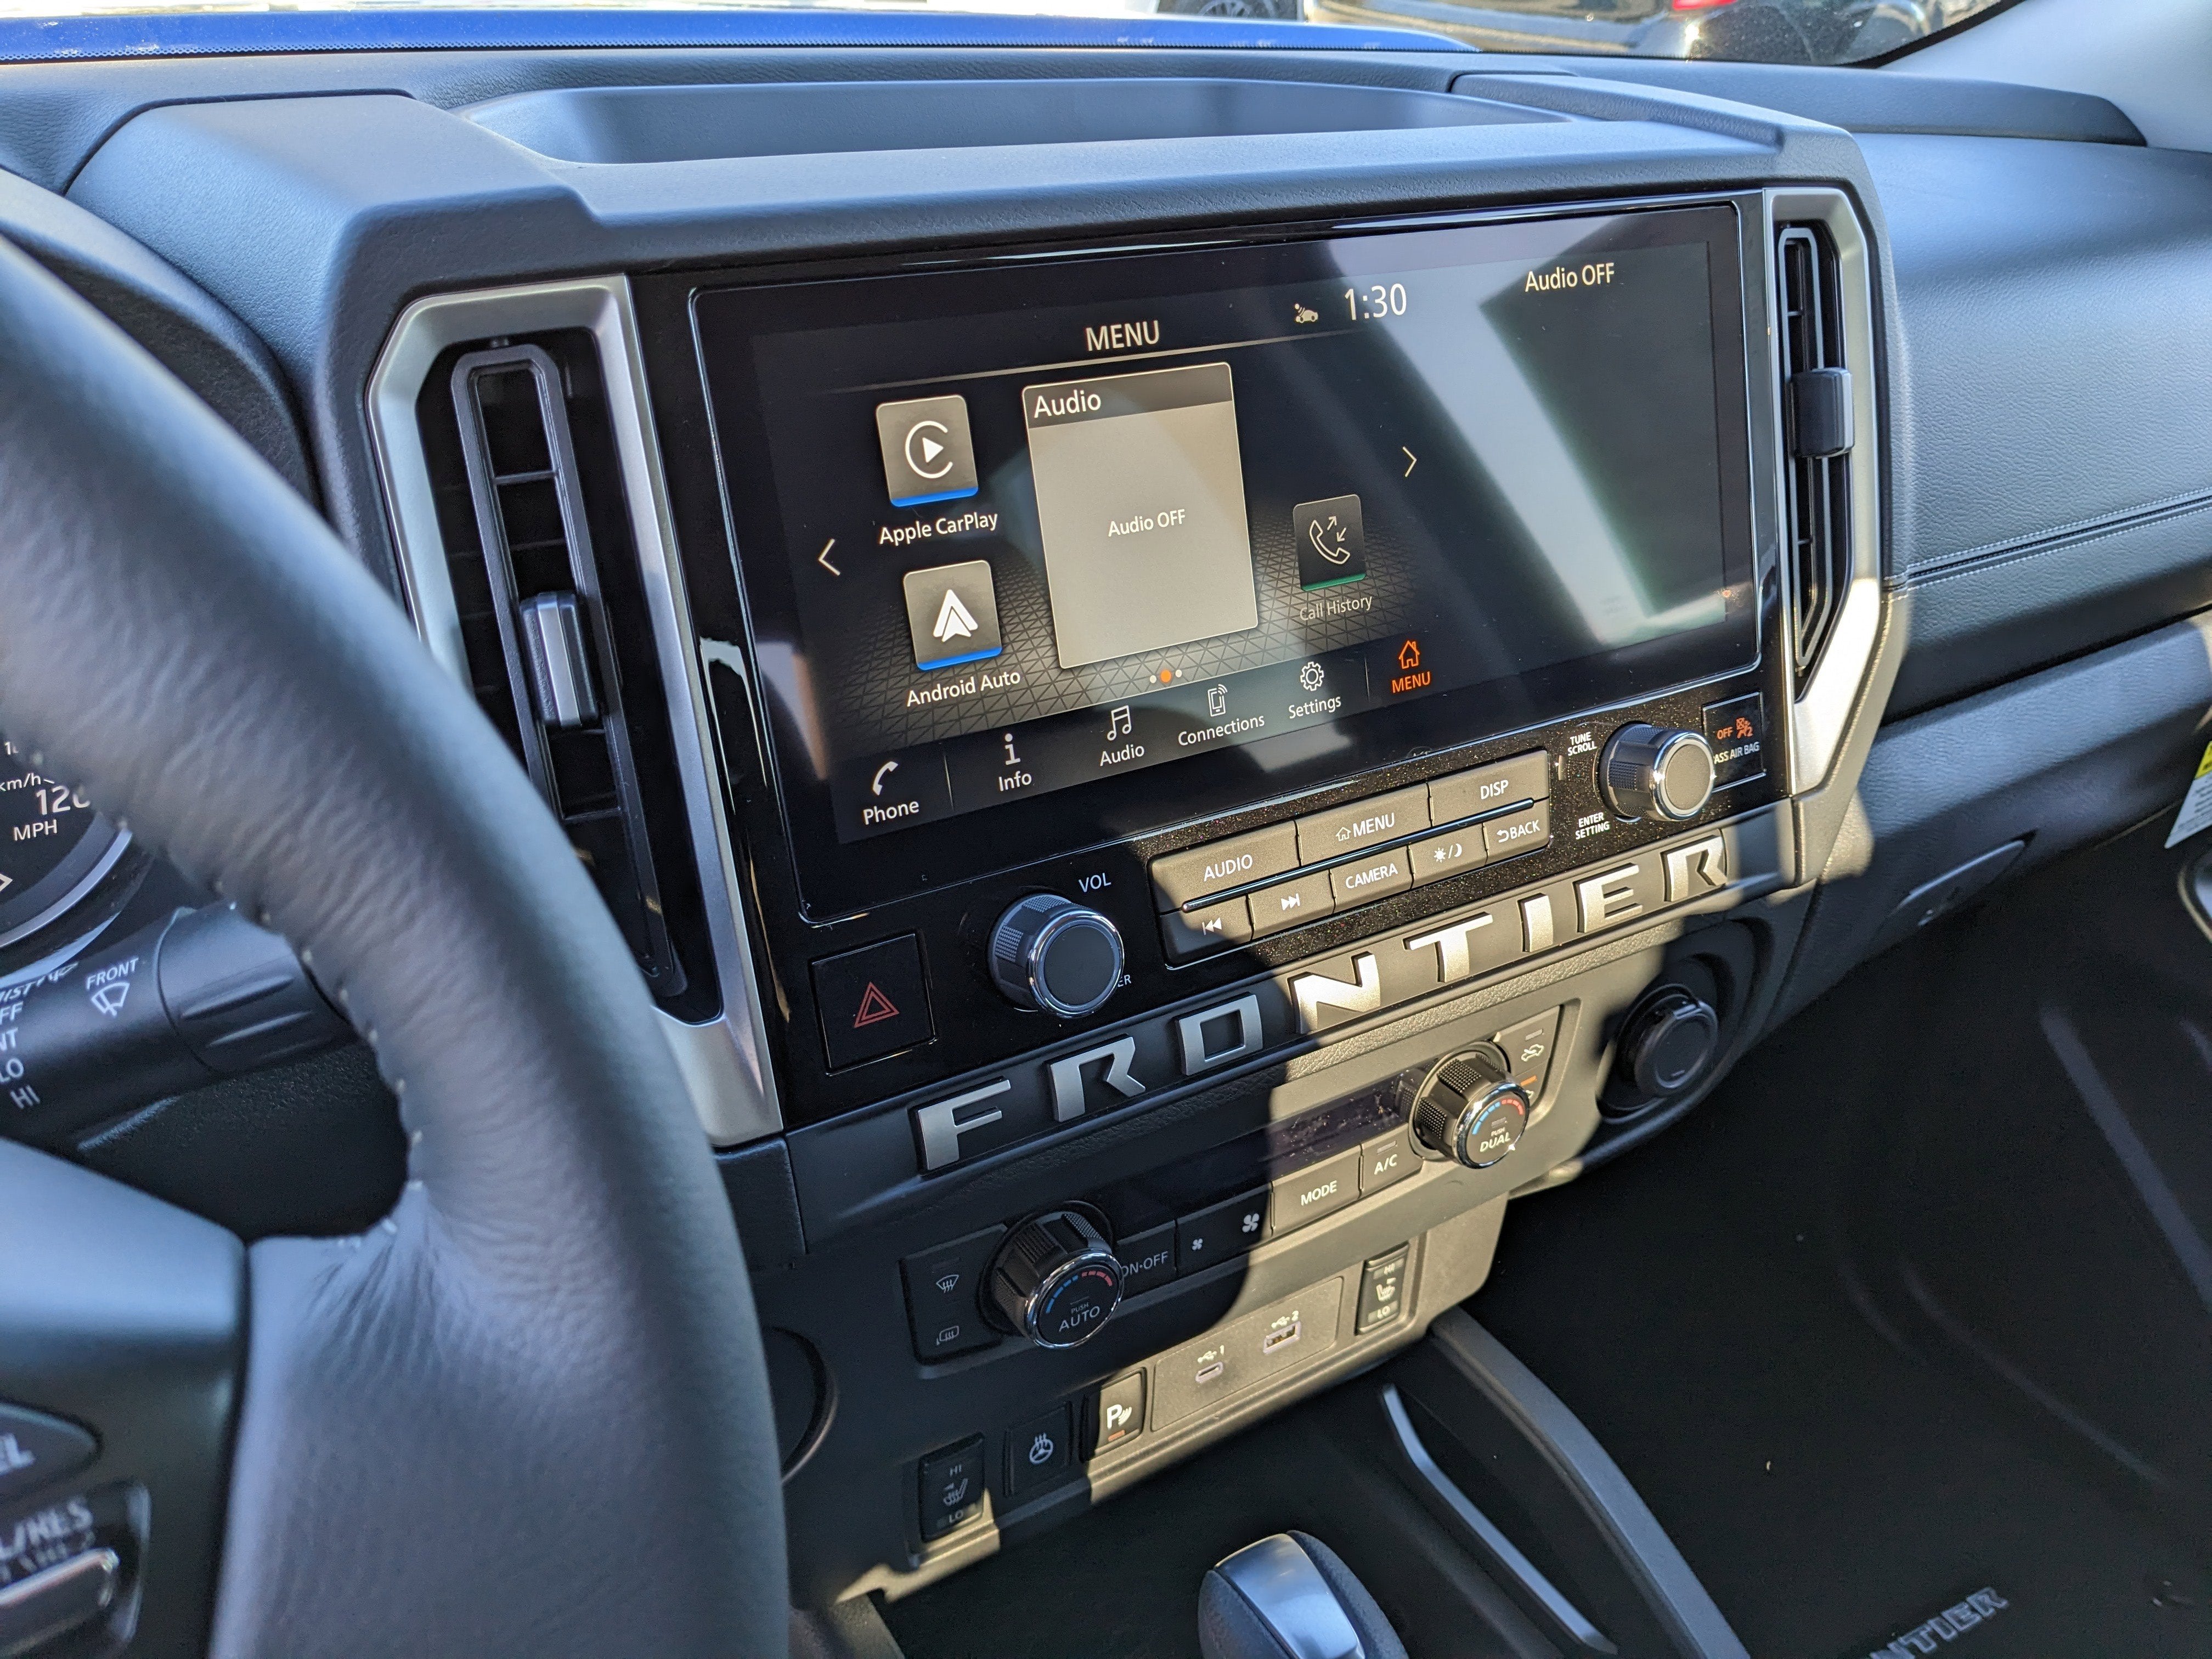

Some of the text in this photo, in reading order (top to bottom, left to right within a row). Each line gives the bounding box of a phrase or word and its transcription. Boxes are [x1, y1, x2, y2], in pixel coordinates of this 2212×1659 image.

[1525, 262, 1615, 292] Audio OFF
[1344, 284, 1407, 321] 1:30
[1085, 320, 1160, 352] MENU
[1034, 389, 1102, 419] Audio
[879, 511, 998, 546] Apple CarPlay
[1108, 509, 1186, 537] Audio OFF
[1299, 596, 1373, 622] Call History
[906, 670, 1021, 708] Android Auto
[1391, 671, 1431, 694] MENU
[1288, 695, 1342, 719] Settings
[1177, 715, 1265, 747] Connections
[1570, 731, 1592, 746] TUNE
[1717, 726, 1734, 740] OFF
[1099, 743, 1145, 767] Audio
[1567, 742, 1598, 757] SCROLL
[1713, 741, 1760, 765] ASS AIR BAG
[998, 771, 1032, 792] Info
[1480, 780, 1509, 800] DISP
[863, 800, 920, 825] Phone
[1578, 812, 1604, 829] ENTER
[12, 819, 58, 842] MPH
[1352, 812, 1395, 838] MENU
[1510, 820, 1541, 840] BACK
[1575, 821, 1610, 840] SETTING
[1203, 854, 1253, 882] AUDIO
[1345, 862, 1398, 890] CAMERA
[1079, 874, 1111, 894] VOL
[86, 957, 139, 990] FRONT
[0, 981, 36, 1002] IST
[915, 829, 1728, 1172] FRONTIER
[0, 1001, 24, 1025] FF
[10, 1085, 41, 1109] HI
[1480, 1132, 1511, 1153] DUAL
[1374, 1154, 1398, 1175] A/C
[1300, 1180, 1338, 1206] MODE
[1058, 1305, 1101, 1333] AUTO
[1071, 1302, 1089, 1314] PUSH
